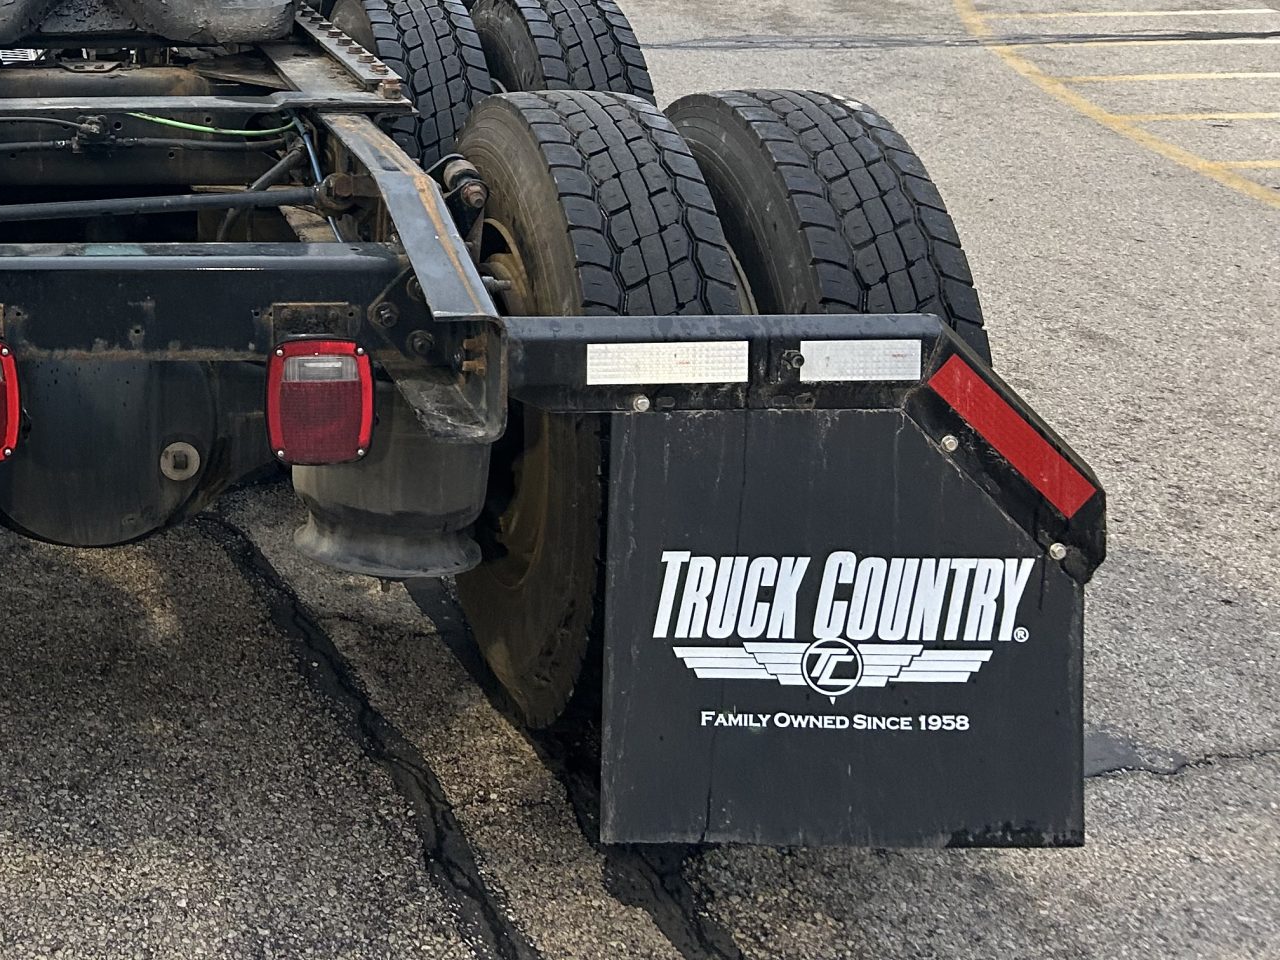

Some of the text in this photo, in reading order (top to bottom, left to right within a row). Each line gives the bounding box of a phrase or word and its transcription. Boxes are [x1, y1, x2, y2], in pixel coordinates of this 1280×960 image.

[652, 550, 811, 639] TRUCK
[700, 710, 970, 731] FAMILY OWNED SINCE 1958
